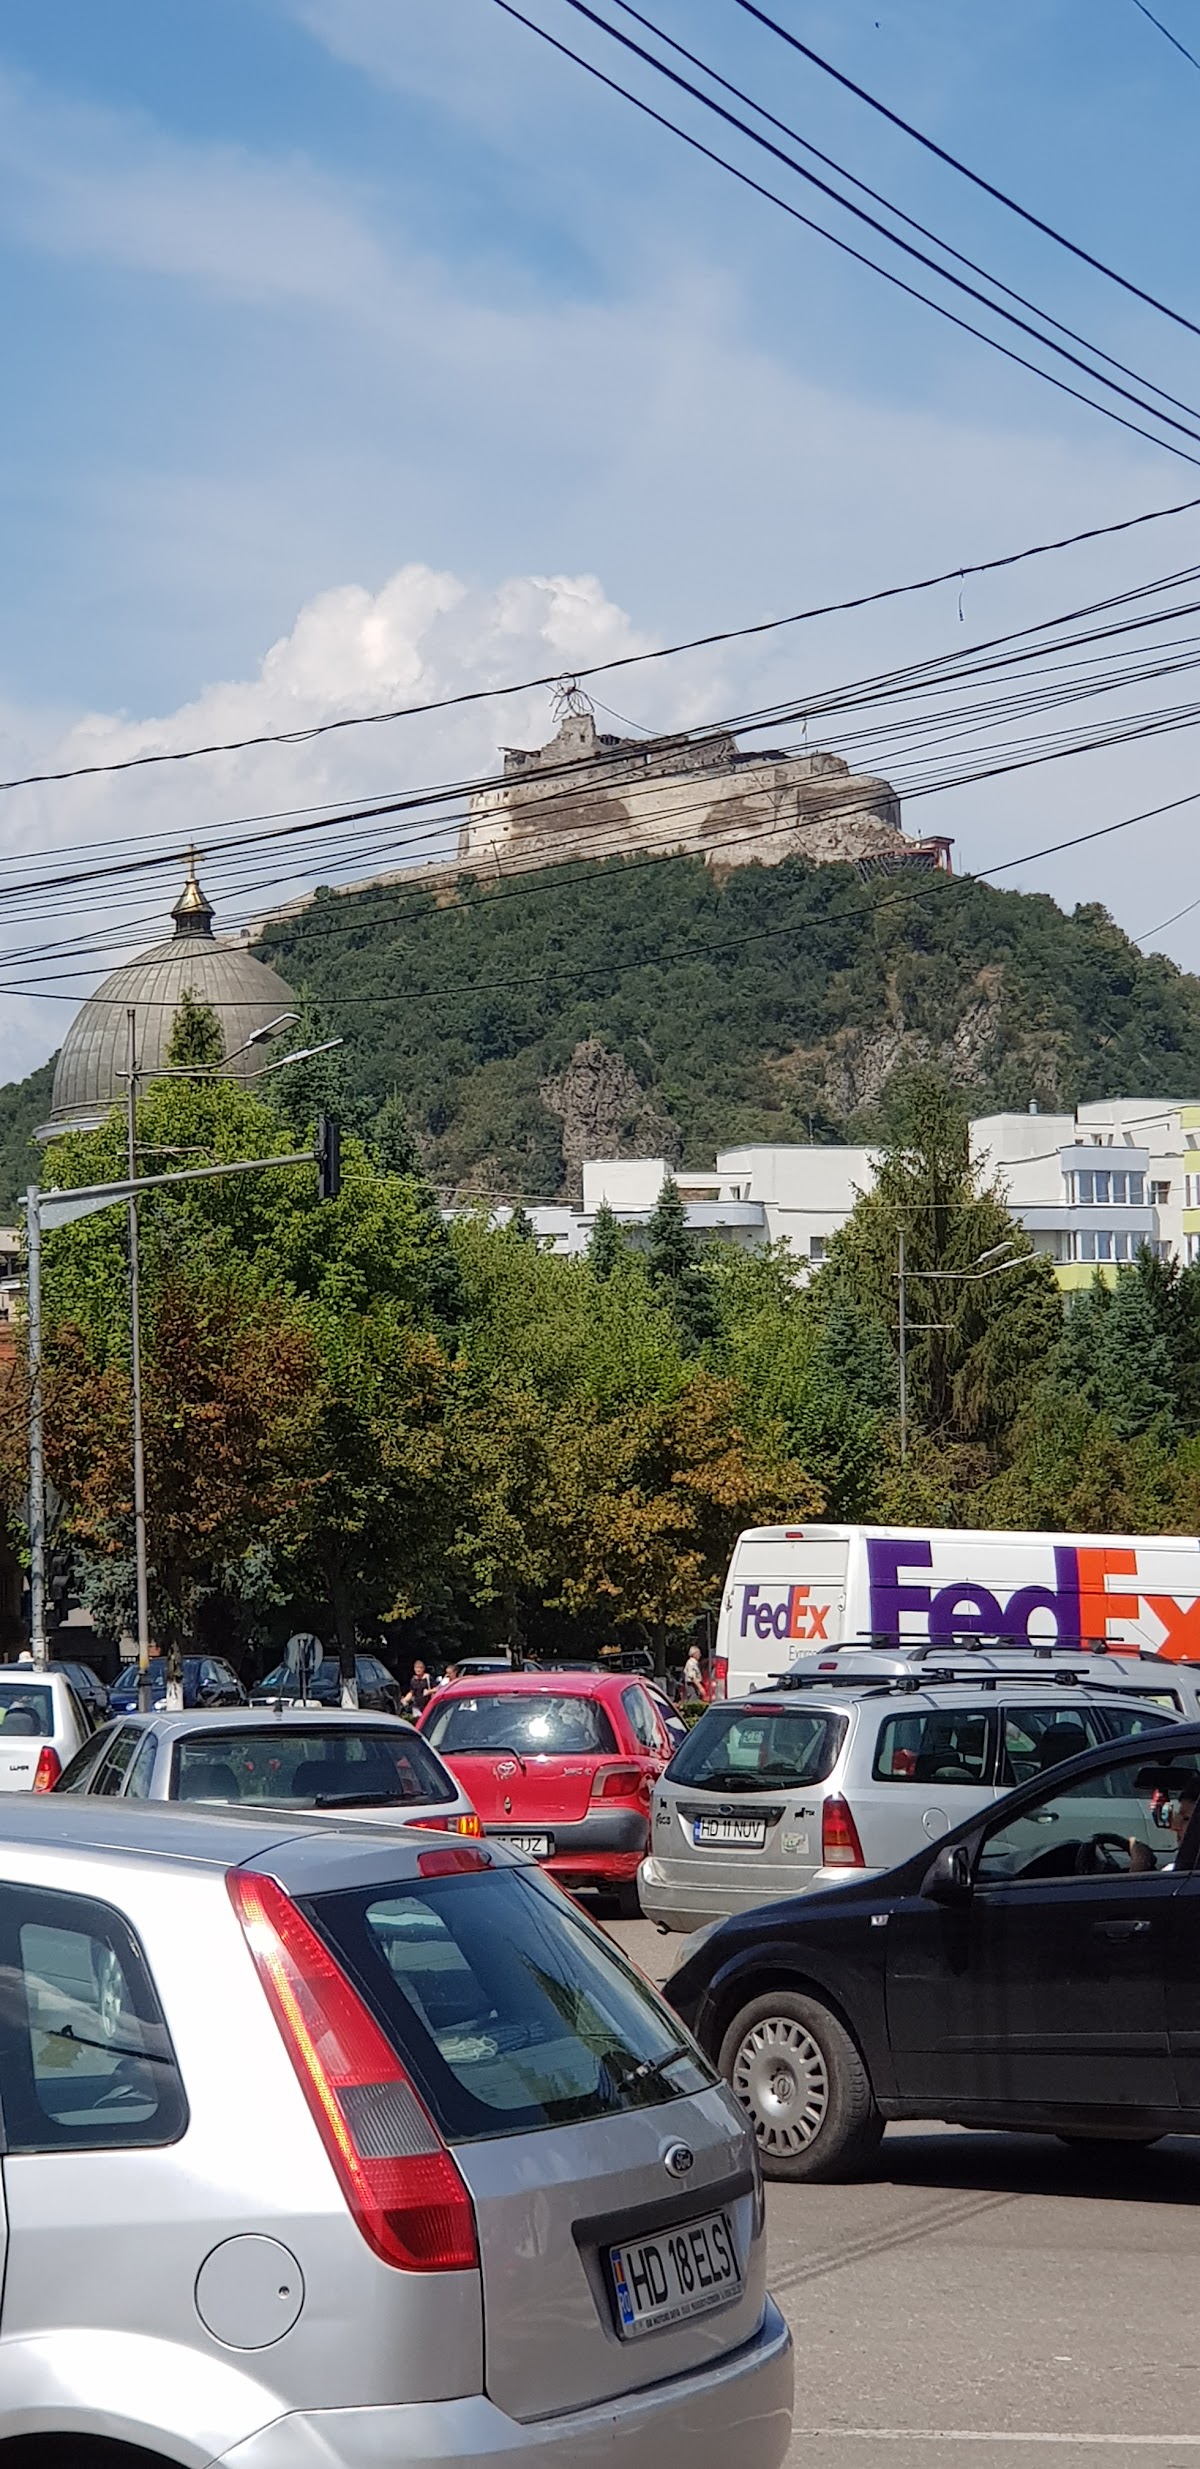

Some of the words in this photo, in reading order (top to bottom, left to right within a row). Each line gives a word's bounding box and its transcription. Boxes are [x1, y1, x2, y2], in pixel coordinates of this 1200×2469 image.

[740, 1585, 831, 1639] FedEx
[867, 1539, 1200, 1663] FedEx
[701, 1819, 719, 1837] HD
[722, 1820, 731, 1837] 11
[733, 1820, 761, 1838] NUV
[626, 2245, 669, 2310] HD
[668, 2236, 694, 2295] 18
[688, 2223, 731, 2288] ELS
